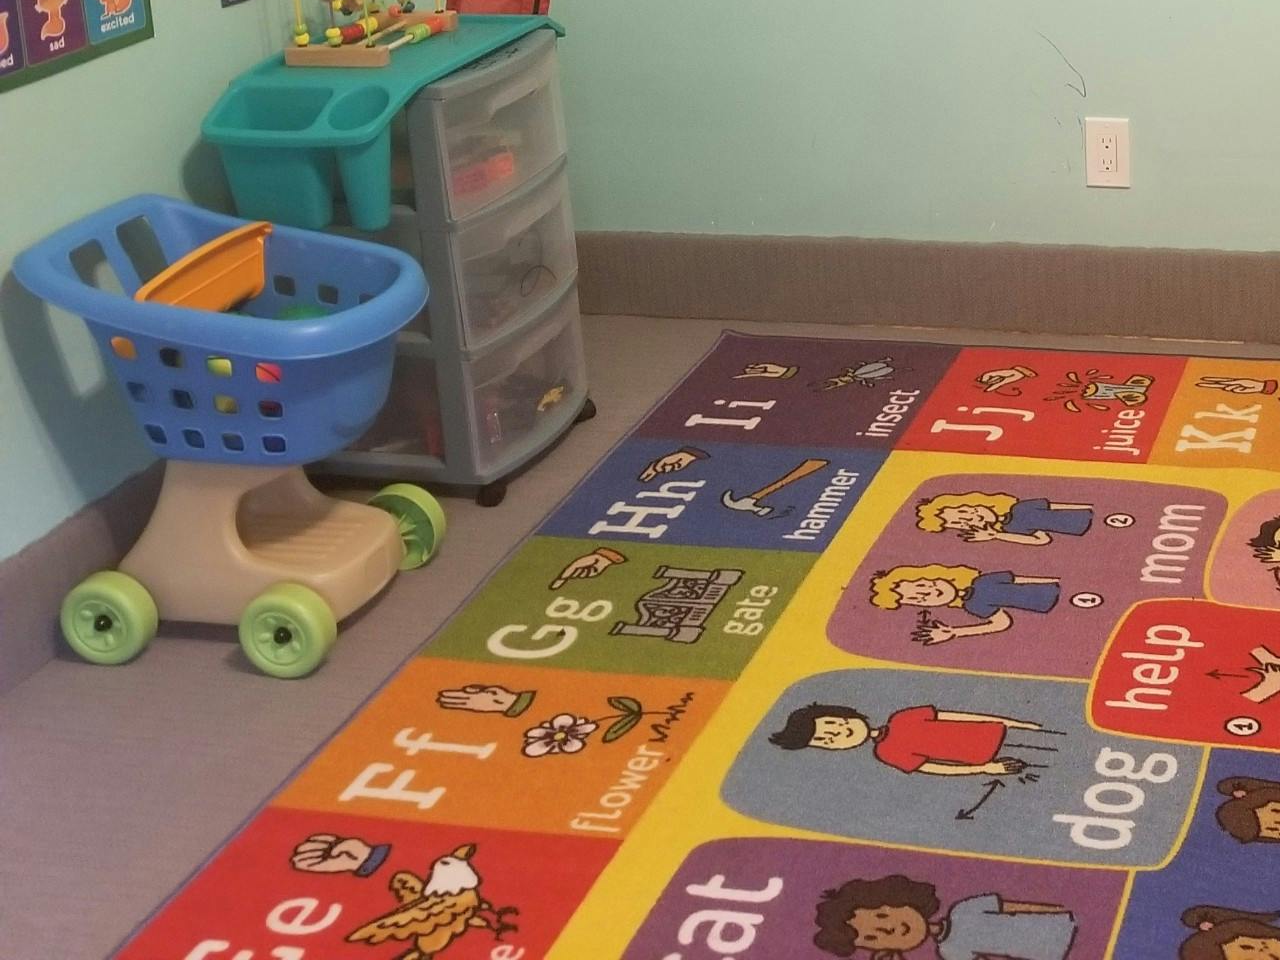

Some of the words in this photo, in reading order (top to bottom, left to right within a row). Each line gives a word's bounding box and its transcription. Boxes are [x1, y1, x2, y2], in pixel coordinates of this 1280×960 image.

[856, 389, 921, 438] insect
[931, 406, 1037, 441] Jj
[1093, 409, 1146, 455] juice
[1175, 403, 1263, 454] Kk
[588, 478, 707, 539] Hh
[782, 468, 860, 541] hammer
[1140, 504, 1206, 584] mom
[487, 595, 612, 659] Gg
[723, 584, 780, 637] gate
[1105, 623, 1205, 712] help
[338, 726, 497, 810] Ff
[570, 744, 666, 833] flower
[1052, 746, 1178, 850] dog
[662, 873, 783, 960] at
